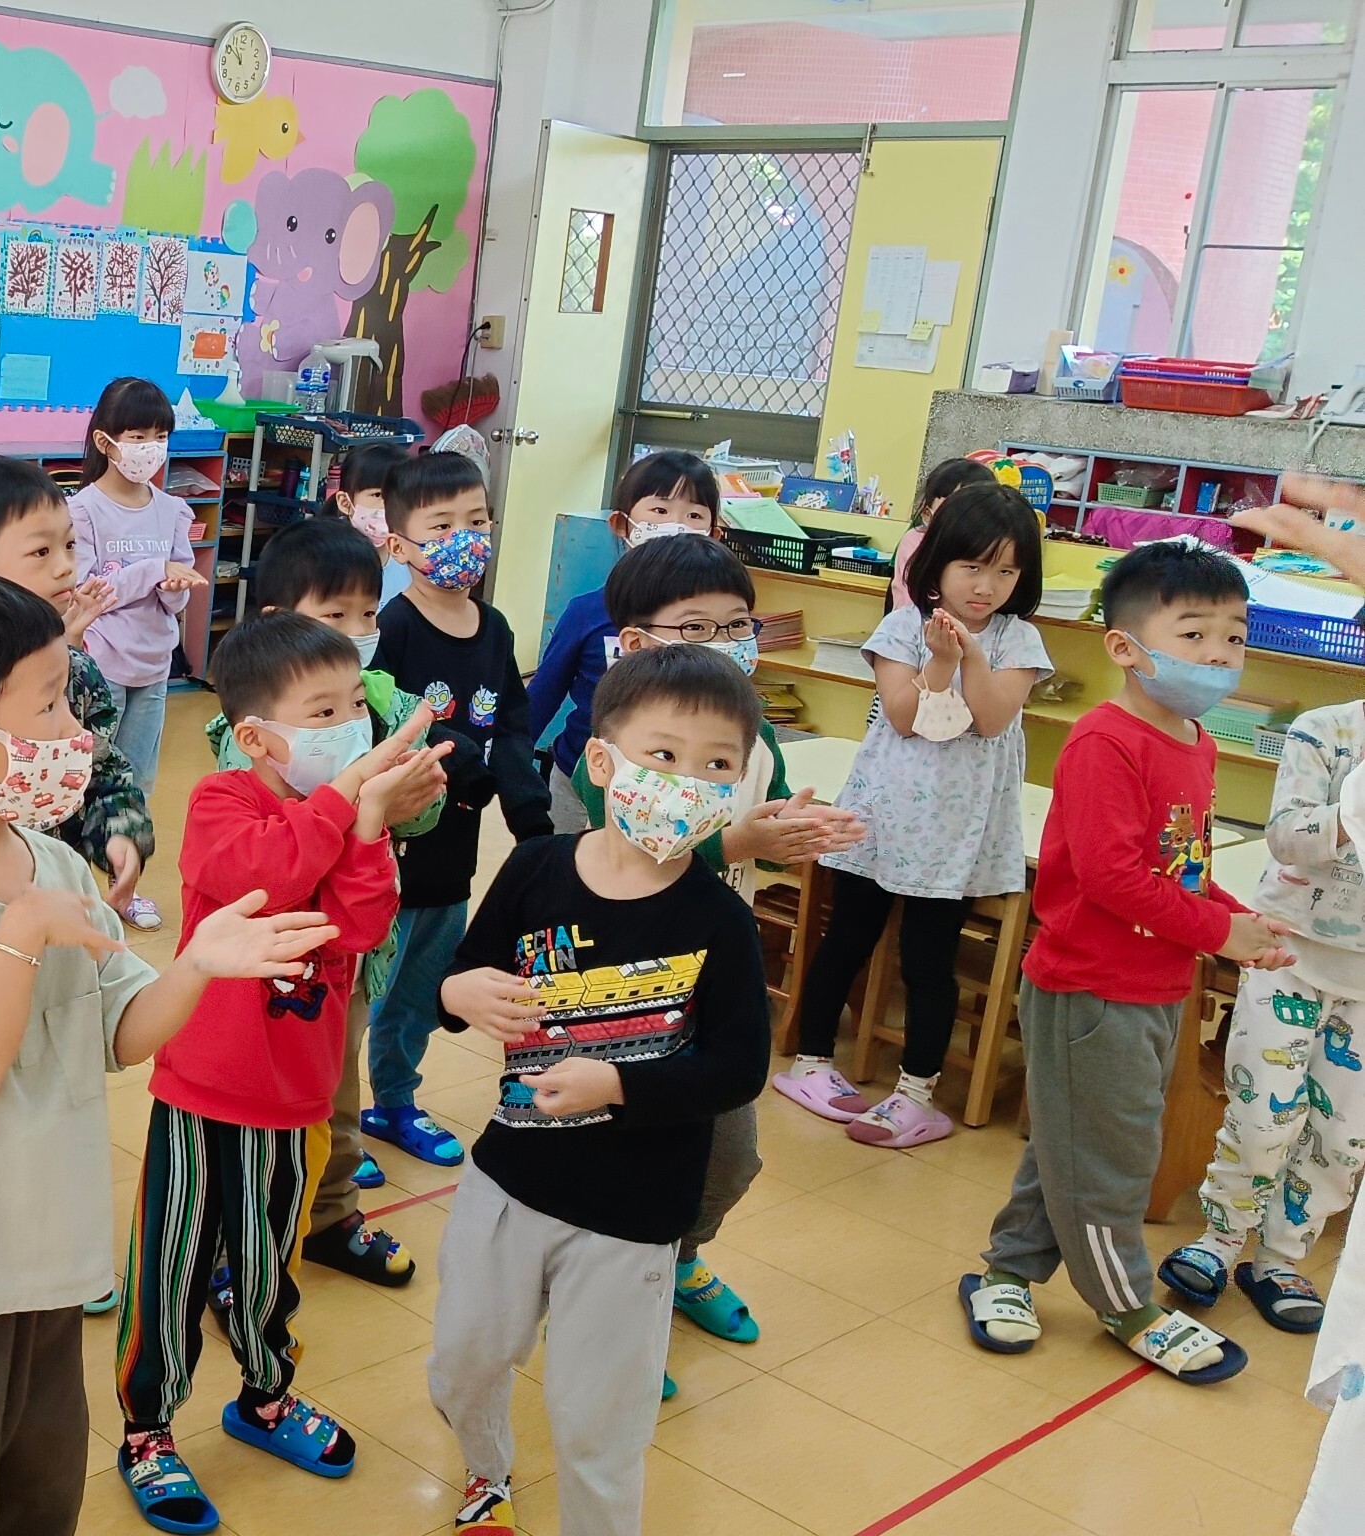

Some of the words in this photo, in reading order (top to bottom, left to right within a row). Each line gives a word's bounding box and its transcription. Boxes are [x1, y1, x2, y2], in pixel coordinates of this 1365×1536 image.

[240, 34, 248, 45] 12
[105, 539, 144, 554] GIRL'S
[146, 540, 172, 553] TIME
[612, 788, 634, 806] WILD
